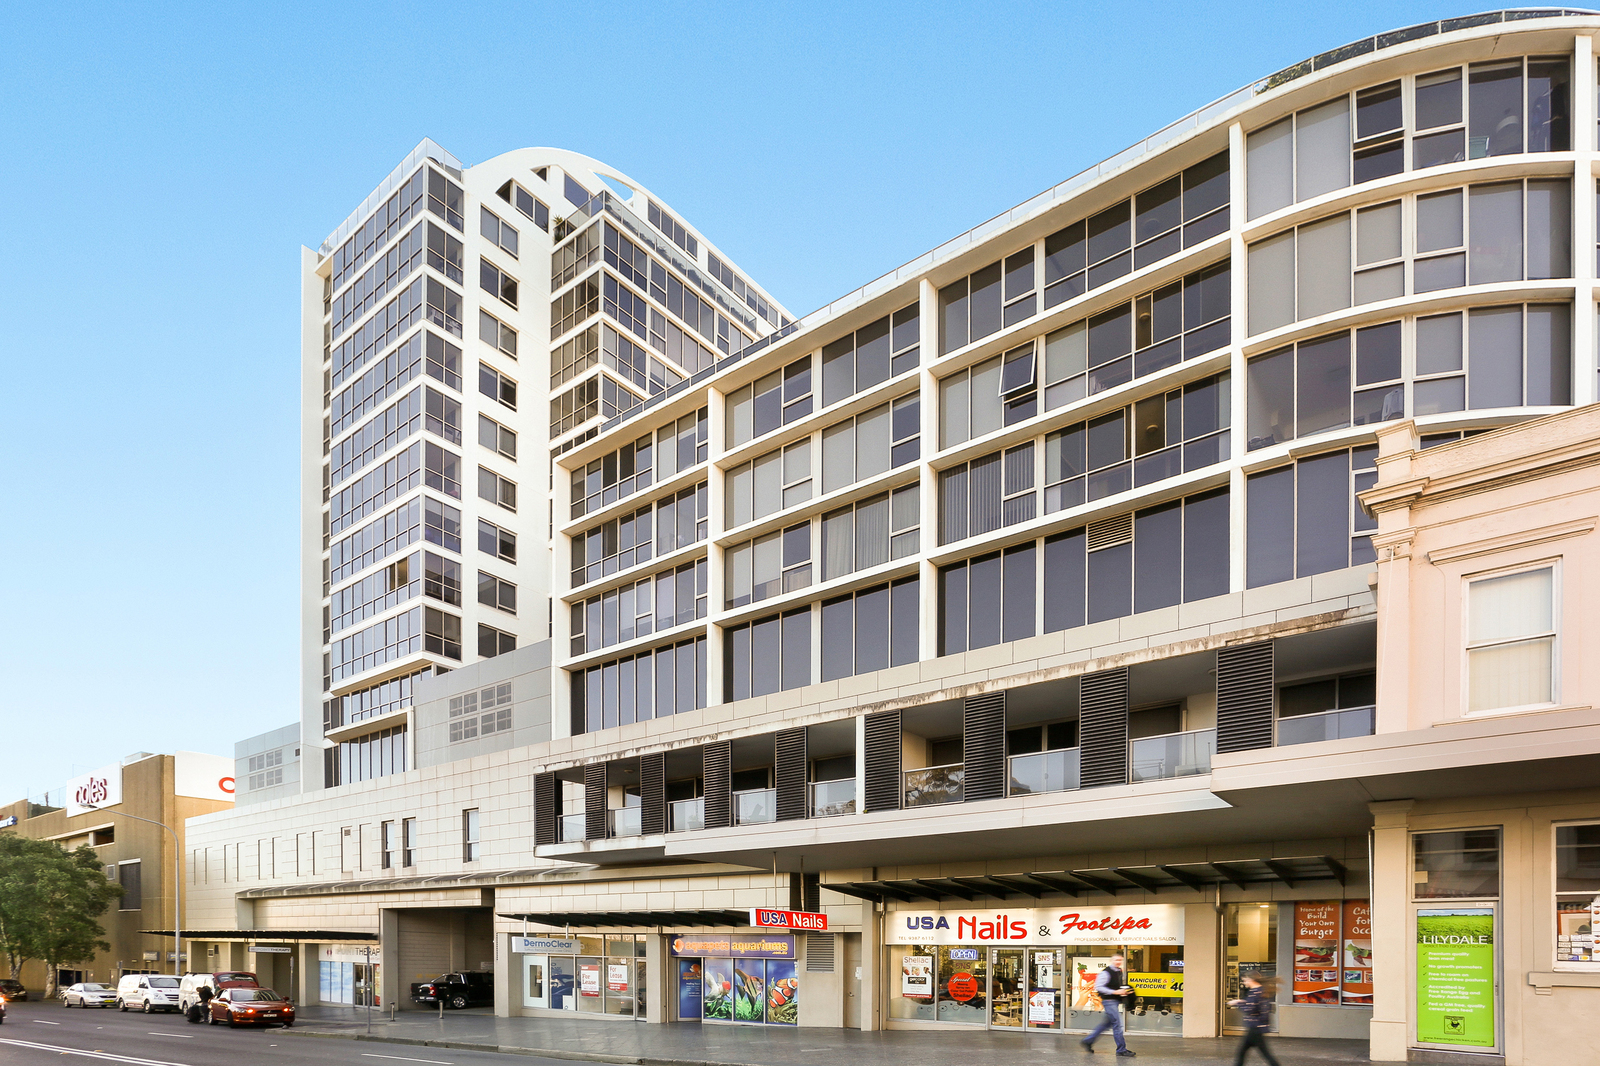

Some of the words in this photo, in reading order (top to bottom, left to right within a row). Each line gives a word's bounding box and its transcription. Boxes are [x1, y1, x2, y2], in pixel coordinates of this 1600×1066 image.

[1352, 907, 1371, 916] Cat
[761, 911, 788, 926] USA
[792, 913, 824, 929] Nails
[907, 916, 950, 930] USA
[958, 914, 1028, 940] Nails
[1038, 925, 1052, 936] &
[1059, 913, 1152, 934] Footspa
[1300, 928, 1334, 939] Burger
[523, 939, 572, 948] DermoClear
[1423, 935, 1488, 944] LILYDALE
[685, 940, 730, 952] aquapets
[732, 939, 788, 954] aquariums
[355, 948, 380, 956] THERAP
[952, 950, 975, 958] OPEN
